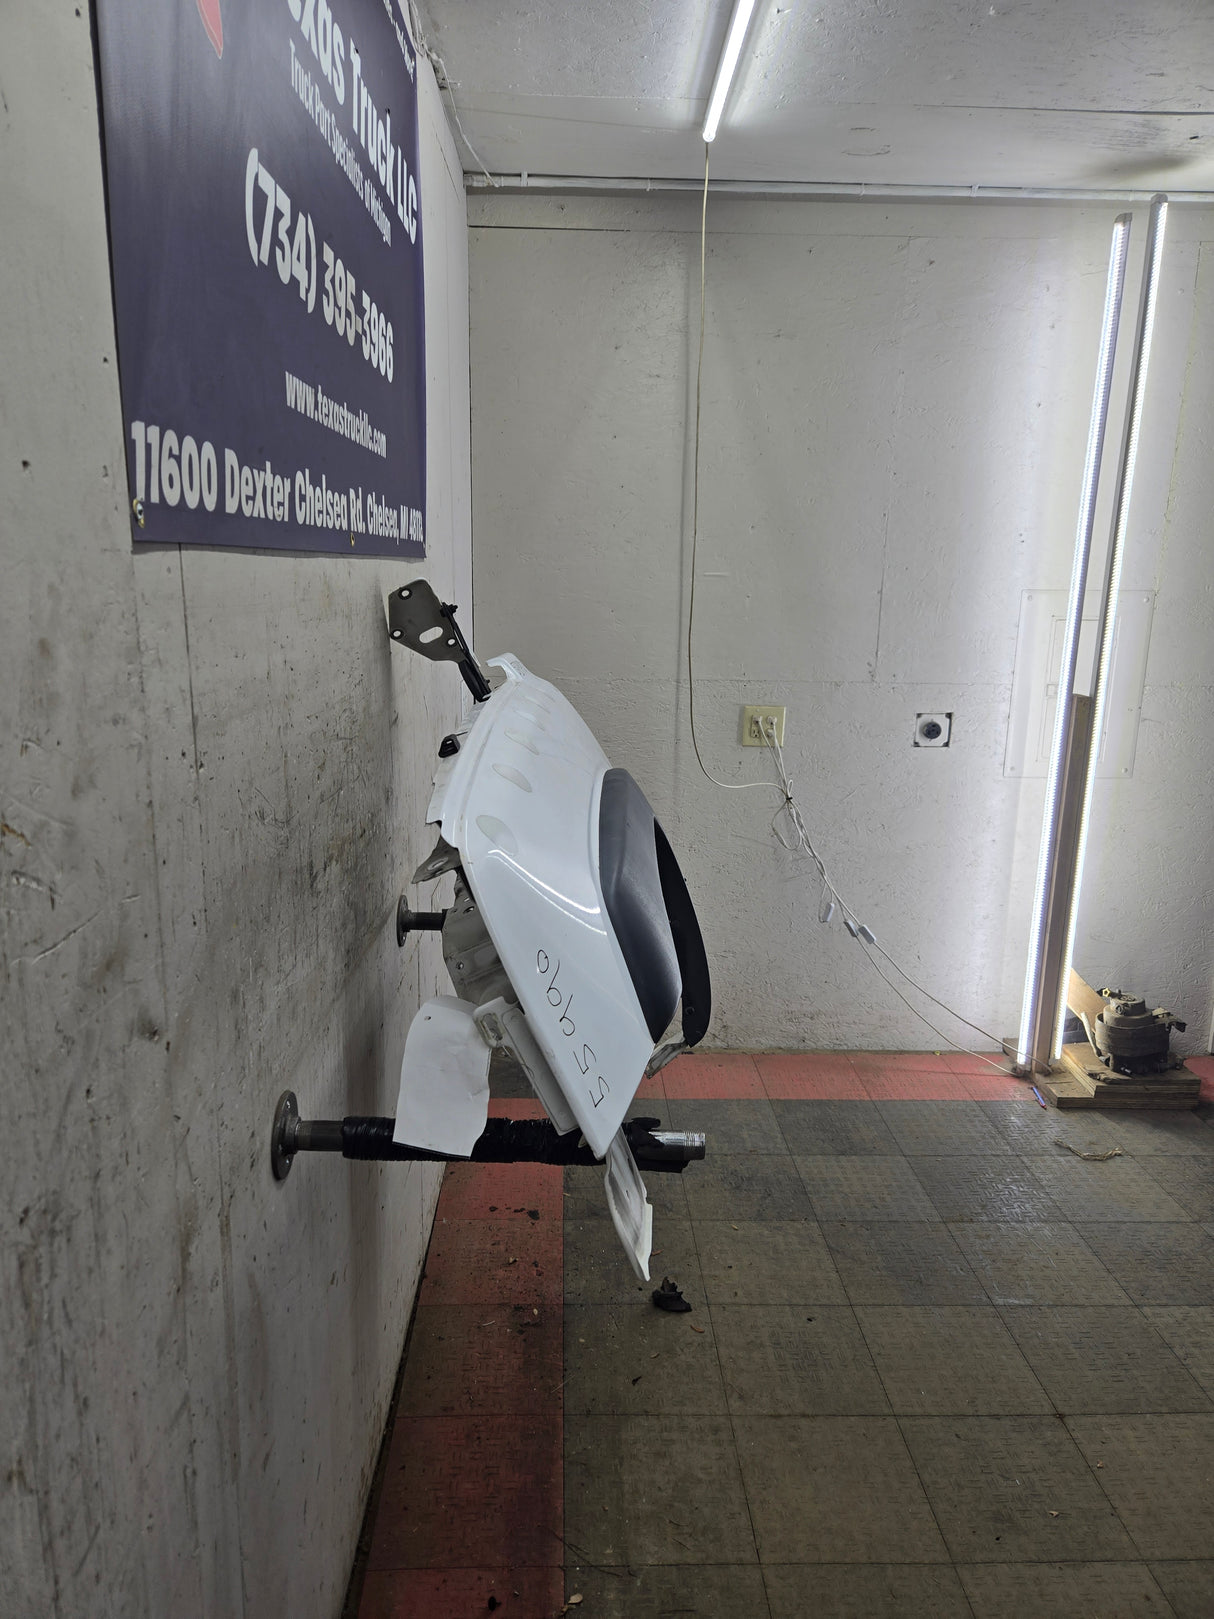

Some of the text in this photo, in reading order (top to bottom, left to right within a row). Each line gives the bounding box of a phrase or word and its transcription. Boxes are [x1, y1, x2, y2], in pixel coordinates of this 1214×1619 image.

[288, 0, 418, 245] xas Truck LLC
[289, 37, 314, 120] Truck
[315, 82, 332, 148] Part
[245, 147, 394, 383] (734) 395-3966
[285, 370, 387, 459] www.texastruckllc.com
[131, 420, 218, 512] 11600
[225, 447, 291, 522] Dexter
[295, 467, 348, 531] Chelsea
[349, 486, 366, 534] Rd.
[367, 491, 400, 546] Chelsea,
[400, 504, 409, 540] MI
